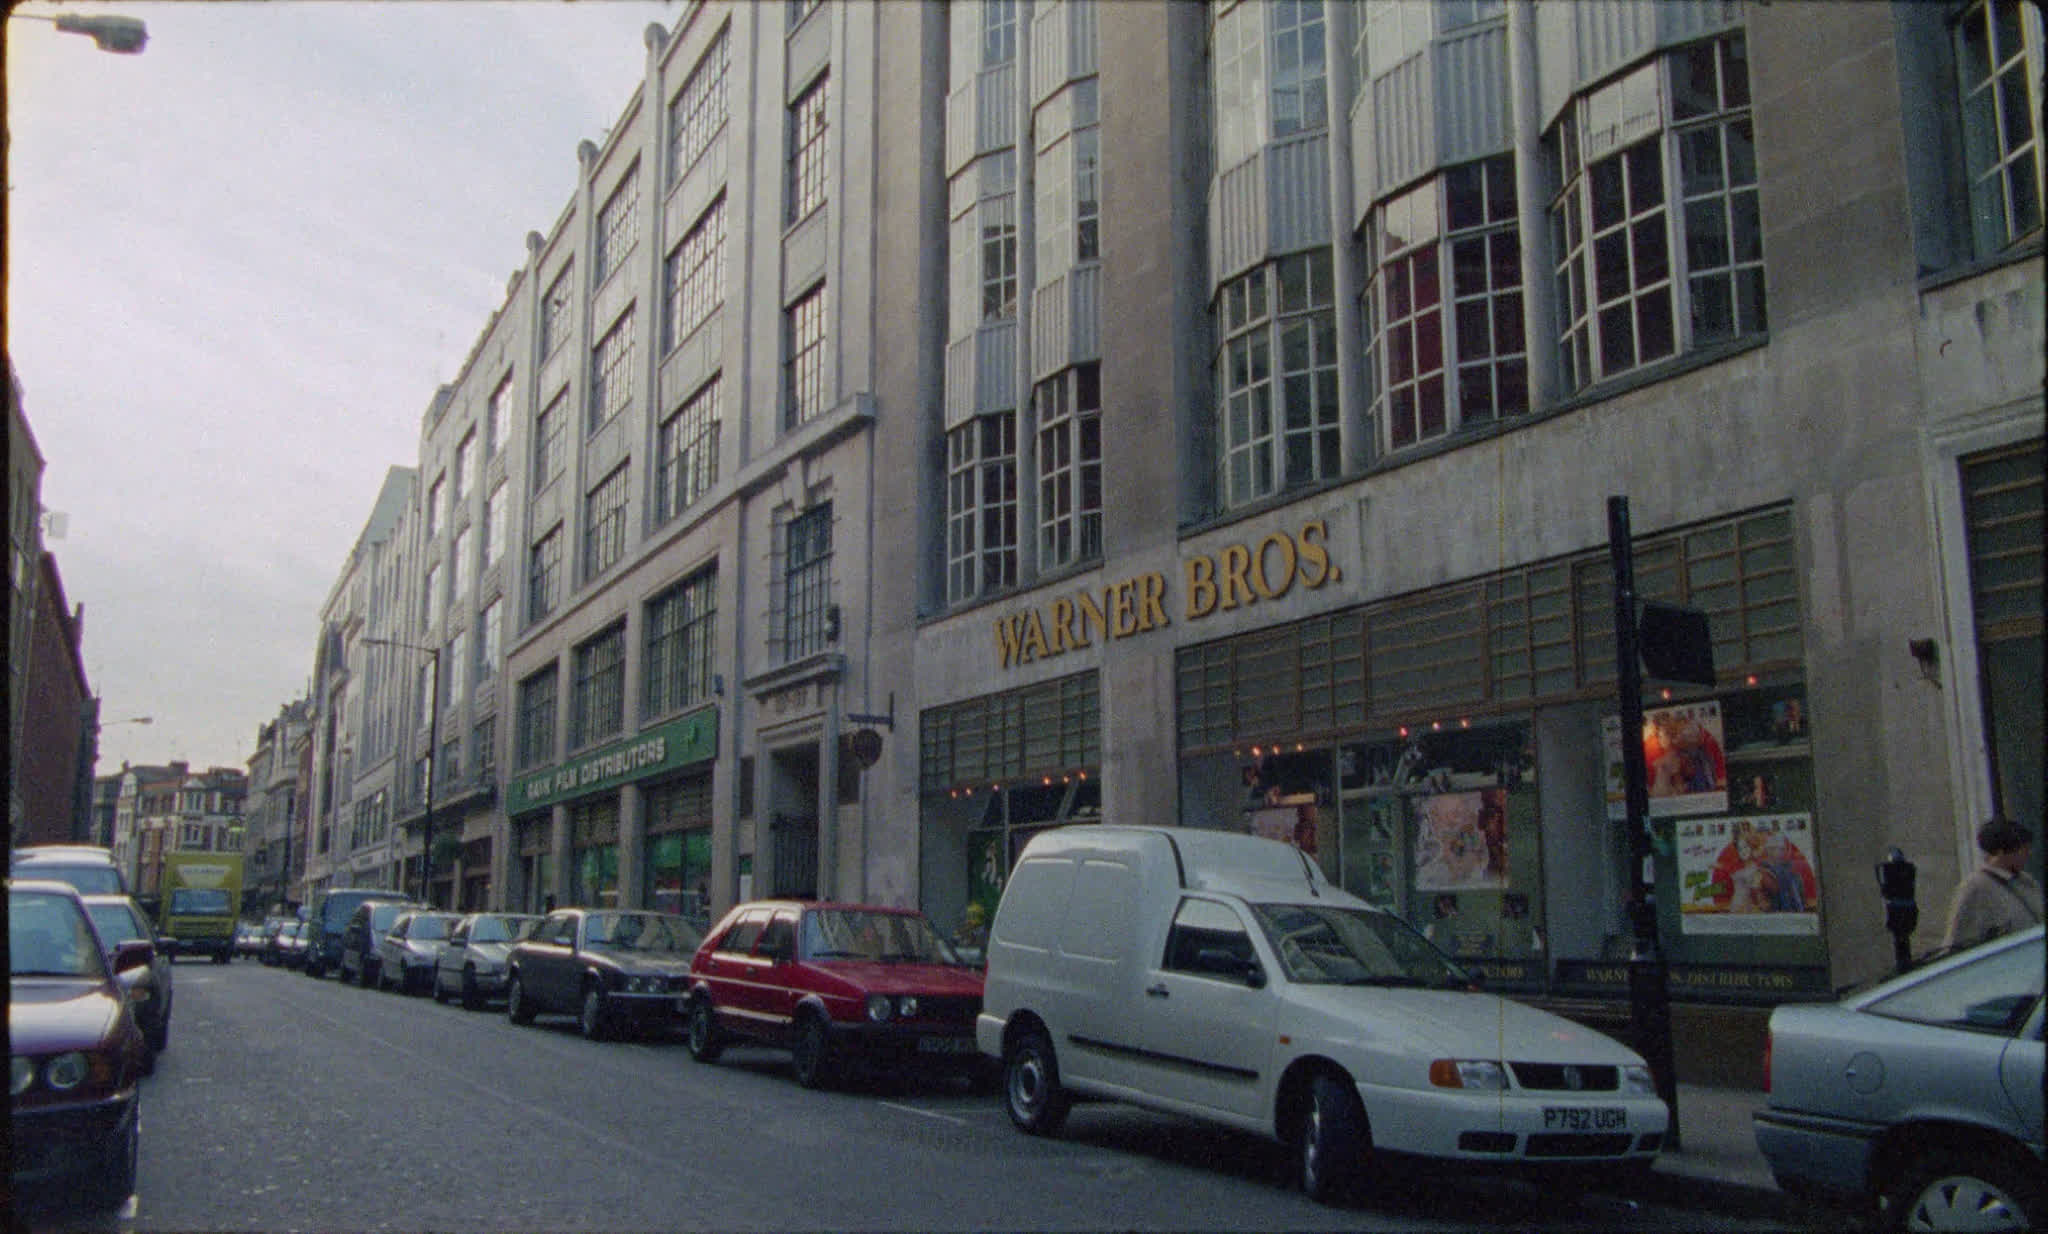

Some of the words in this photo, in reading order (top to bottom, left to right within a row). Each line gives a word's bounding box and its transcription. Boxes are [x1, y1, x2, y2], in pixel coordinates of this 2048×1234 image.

[994, 570, 1170, 669] WARNER
[1184, 519, 1342, 622] BROS.
[580, 736, 666, 785] DISTRIBUTORS
